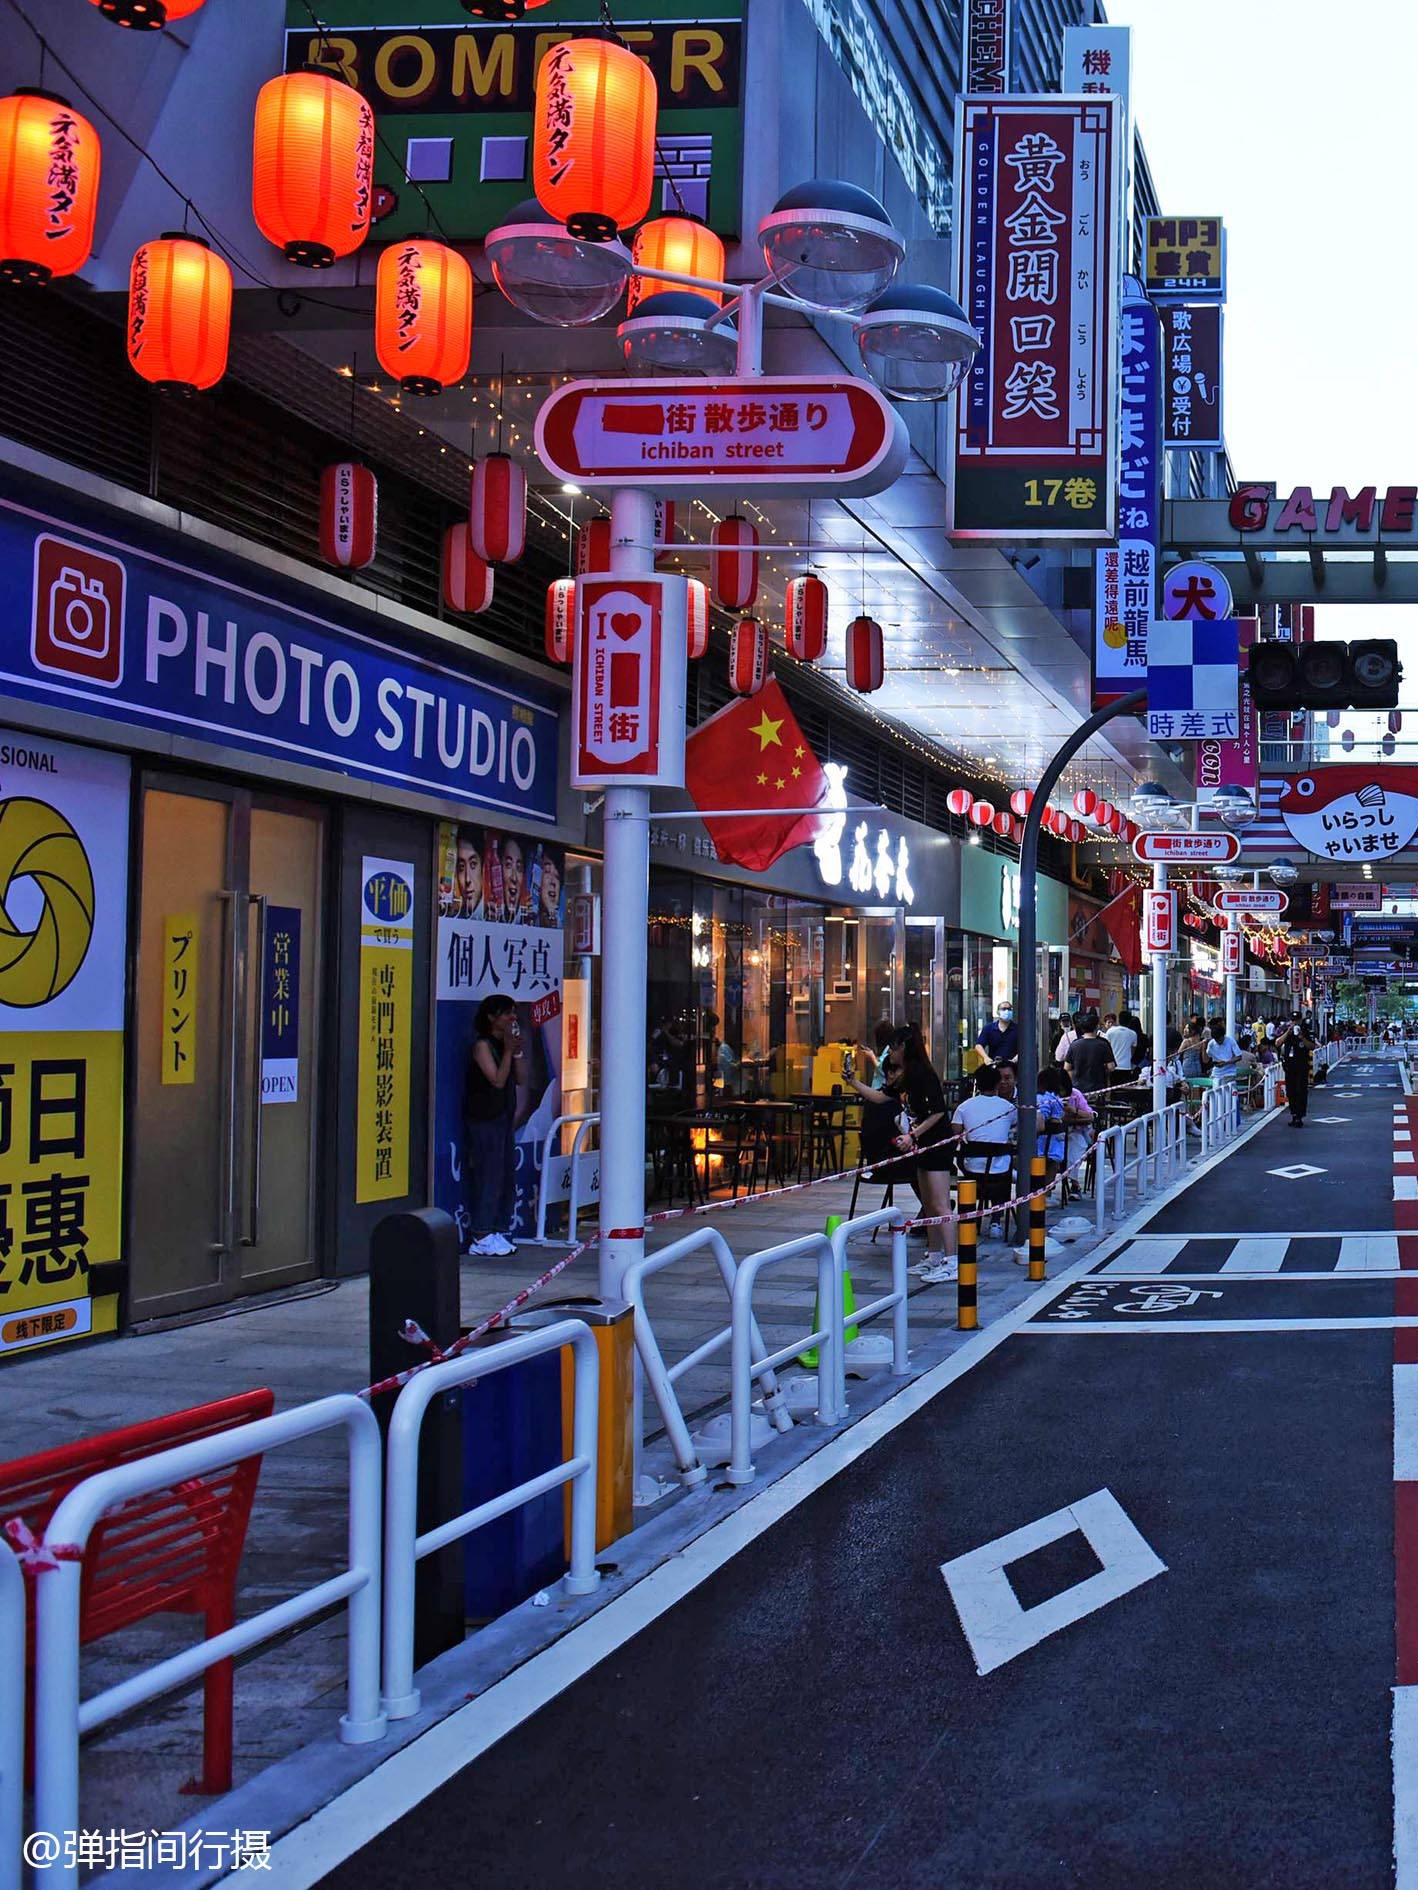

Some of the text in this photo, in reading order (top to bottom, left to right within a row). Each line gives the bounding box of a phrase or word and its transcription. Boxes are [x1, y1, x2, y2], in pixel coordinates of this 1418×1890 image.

[308, 29, 725, 99] BOMR
[546, 47, 576, 187] 元気満タン
[46, 113, 80, 241] 元気満タン
[978, 142, 989, 225] GOLDEN
[1149, 219, 1217, 247] MP3
[396, 246, 423, 352] 元気満タン
[1164, 277, 1207, 287] 24H
[973, 367, 984, 408] BUN
[704, 403, 828, 434] 散歩通り
[641, 442, 784, 460] ichiban street
[340, 468, 350, 543] いらっしゃいませ
[1228, 486, 1418, 532] GAME
[597, 612, 607, 640] I
[1123, 549, 1150, 668] 越前龍馬
[147, 595, 537, 792] PHOTO STUDIO
[593, 648, 605, 744] ICHIBAN STREET
[609, 712, 639, 744] 街
[1150, 711, 1237, 738] 時差式
[1, 746, 58, 773] SIONAL
[1322, 808, 1395, 832] いらっし
[170, 934, 194, 1073] プリント
[271, 932, 291, 1038] 営業中
[262, 1074, 296, 1095] OPEN
[375, 963, 396, 1182] 専門撮影装置
[15, 1313, 66, 1339] 线下限定
